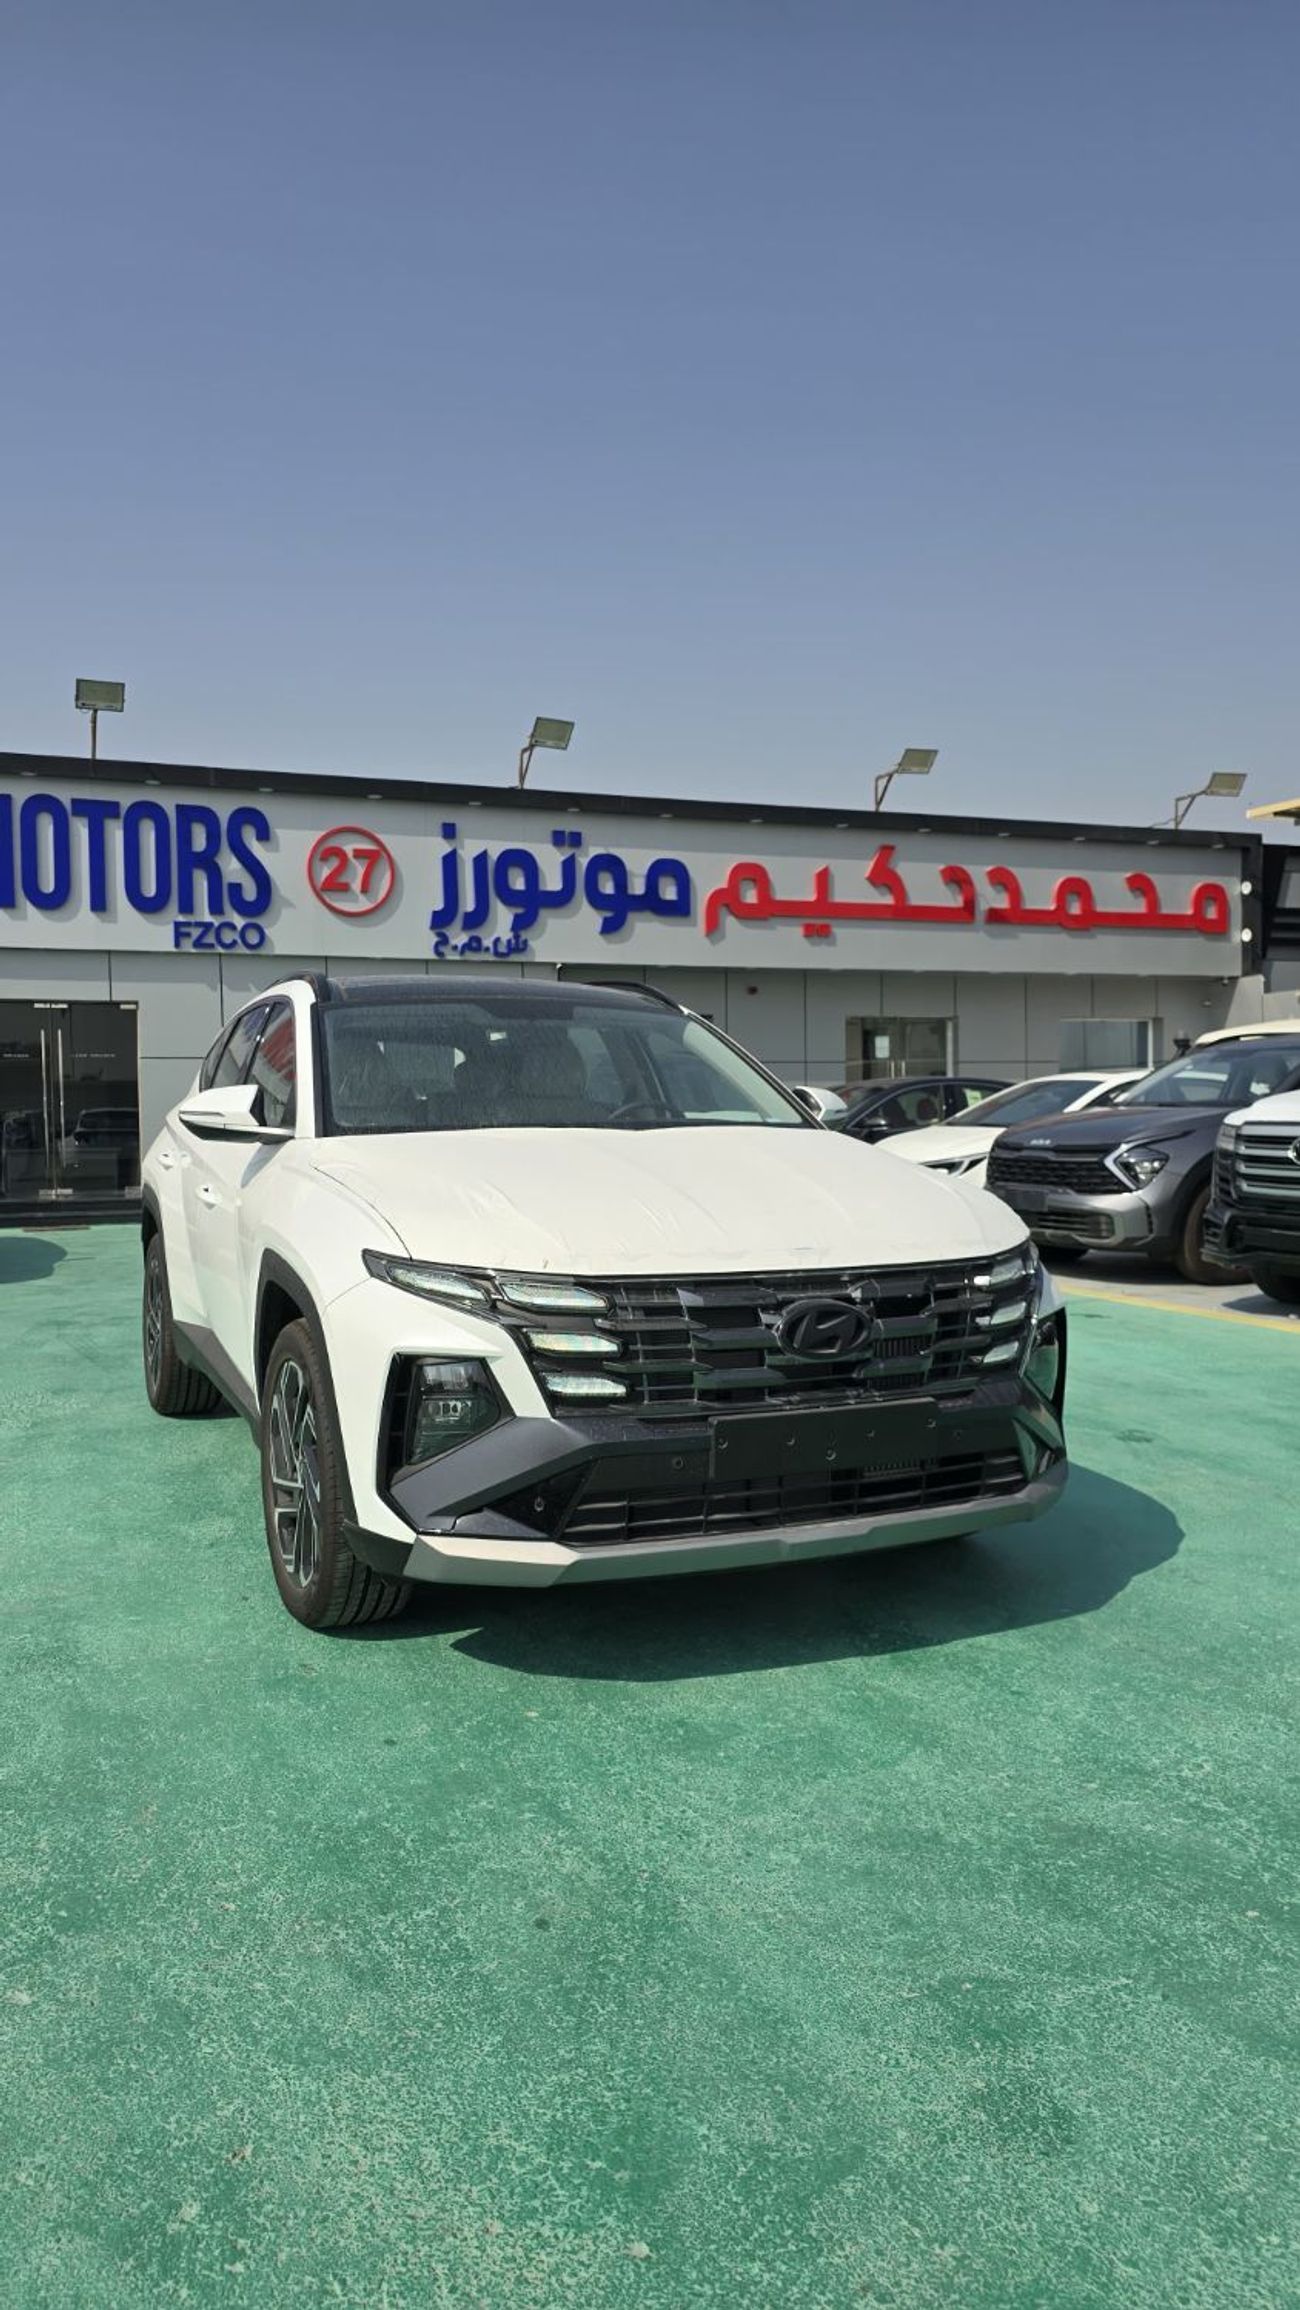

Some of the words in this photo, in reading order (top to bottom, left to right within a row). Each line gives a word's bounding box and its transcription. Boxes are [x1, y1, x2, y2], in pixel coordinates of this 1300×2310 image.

[319, 846, 385, 893] 27
[430, 822, 692, 935] موتورز
[704, 845, 976, 938] حكيم
[984, 866, 1229, 935] محمد
[173, 920, 266, 950] FZCO
